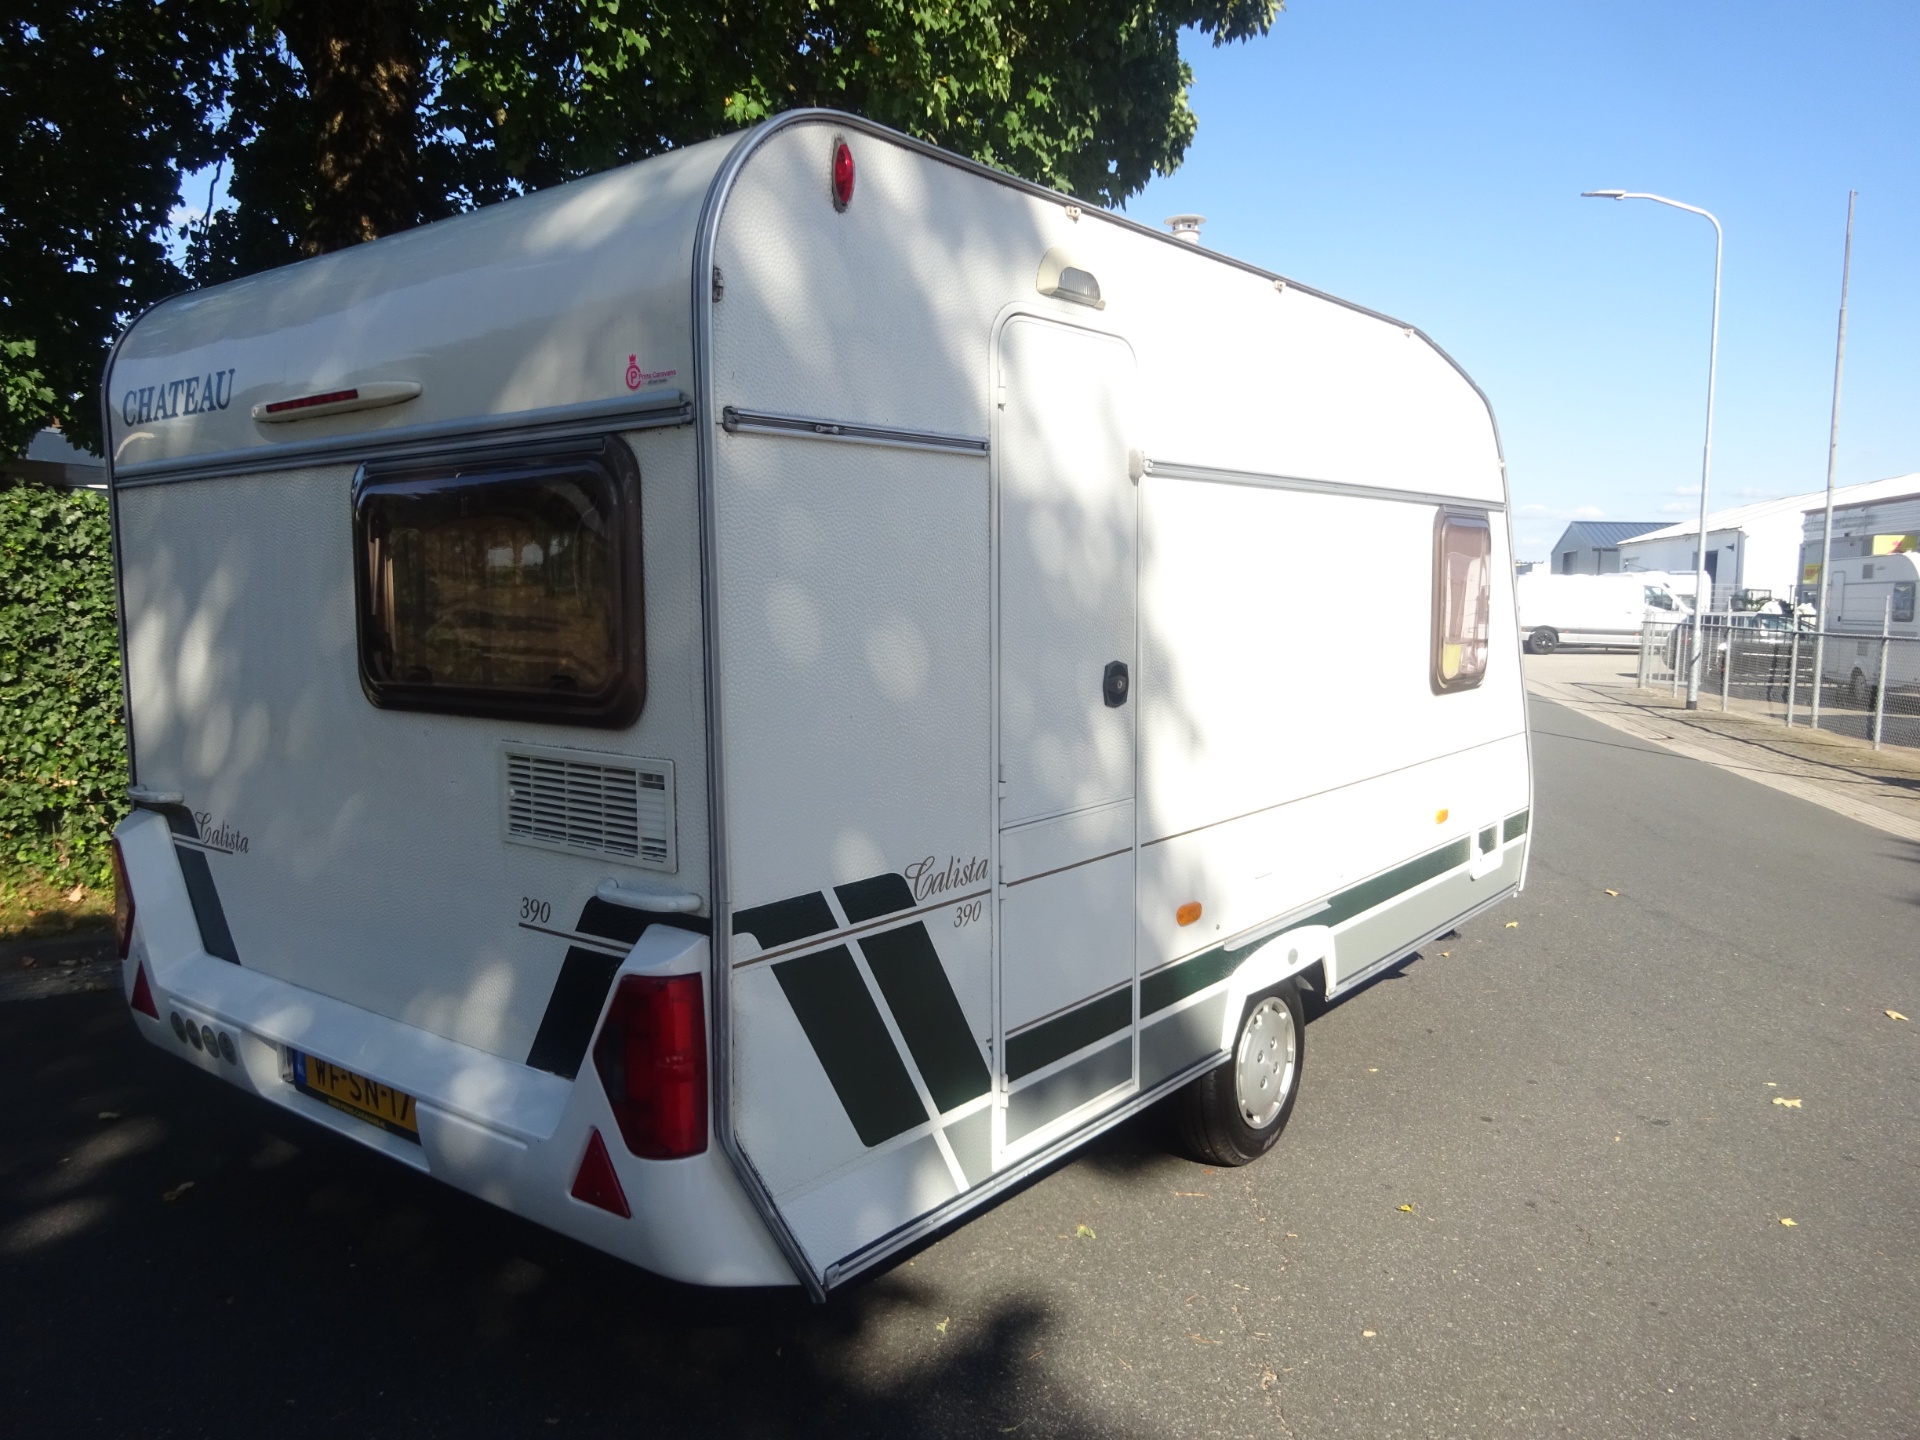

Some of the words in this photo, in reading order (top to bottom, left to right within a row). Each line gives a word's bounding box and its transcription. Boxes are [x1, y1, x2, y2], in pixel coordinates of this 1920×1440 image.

[652, 369, 677, 379] Caravans
[122, 368, 236, 427] CHATEAU
[194, 811, 249, 854] Calista
[904, 855, 989, 901] Calista
[520, 896, 551, 923] 390
[953, 900, 982, 928] 390
